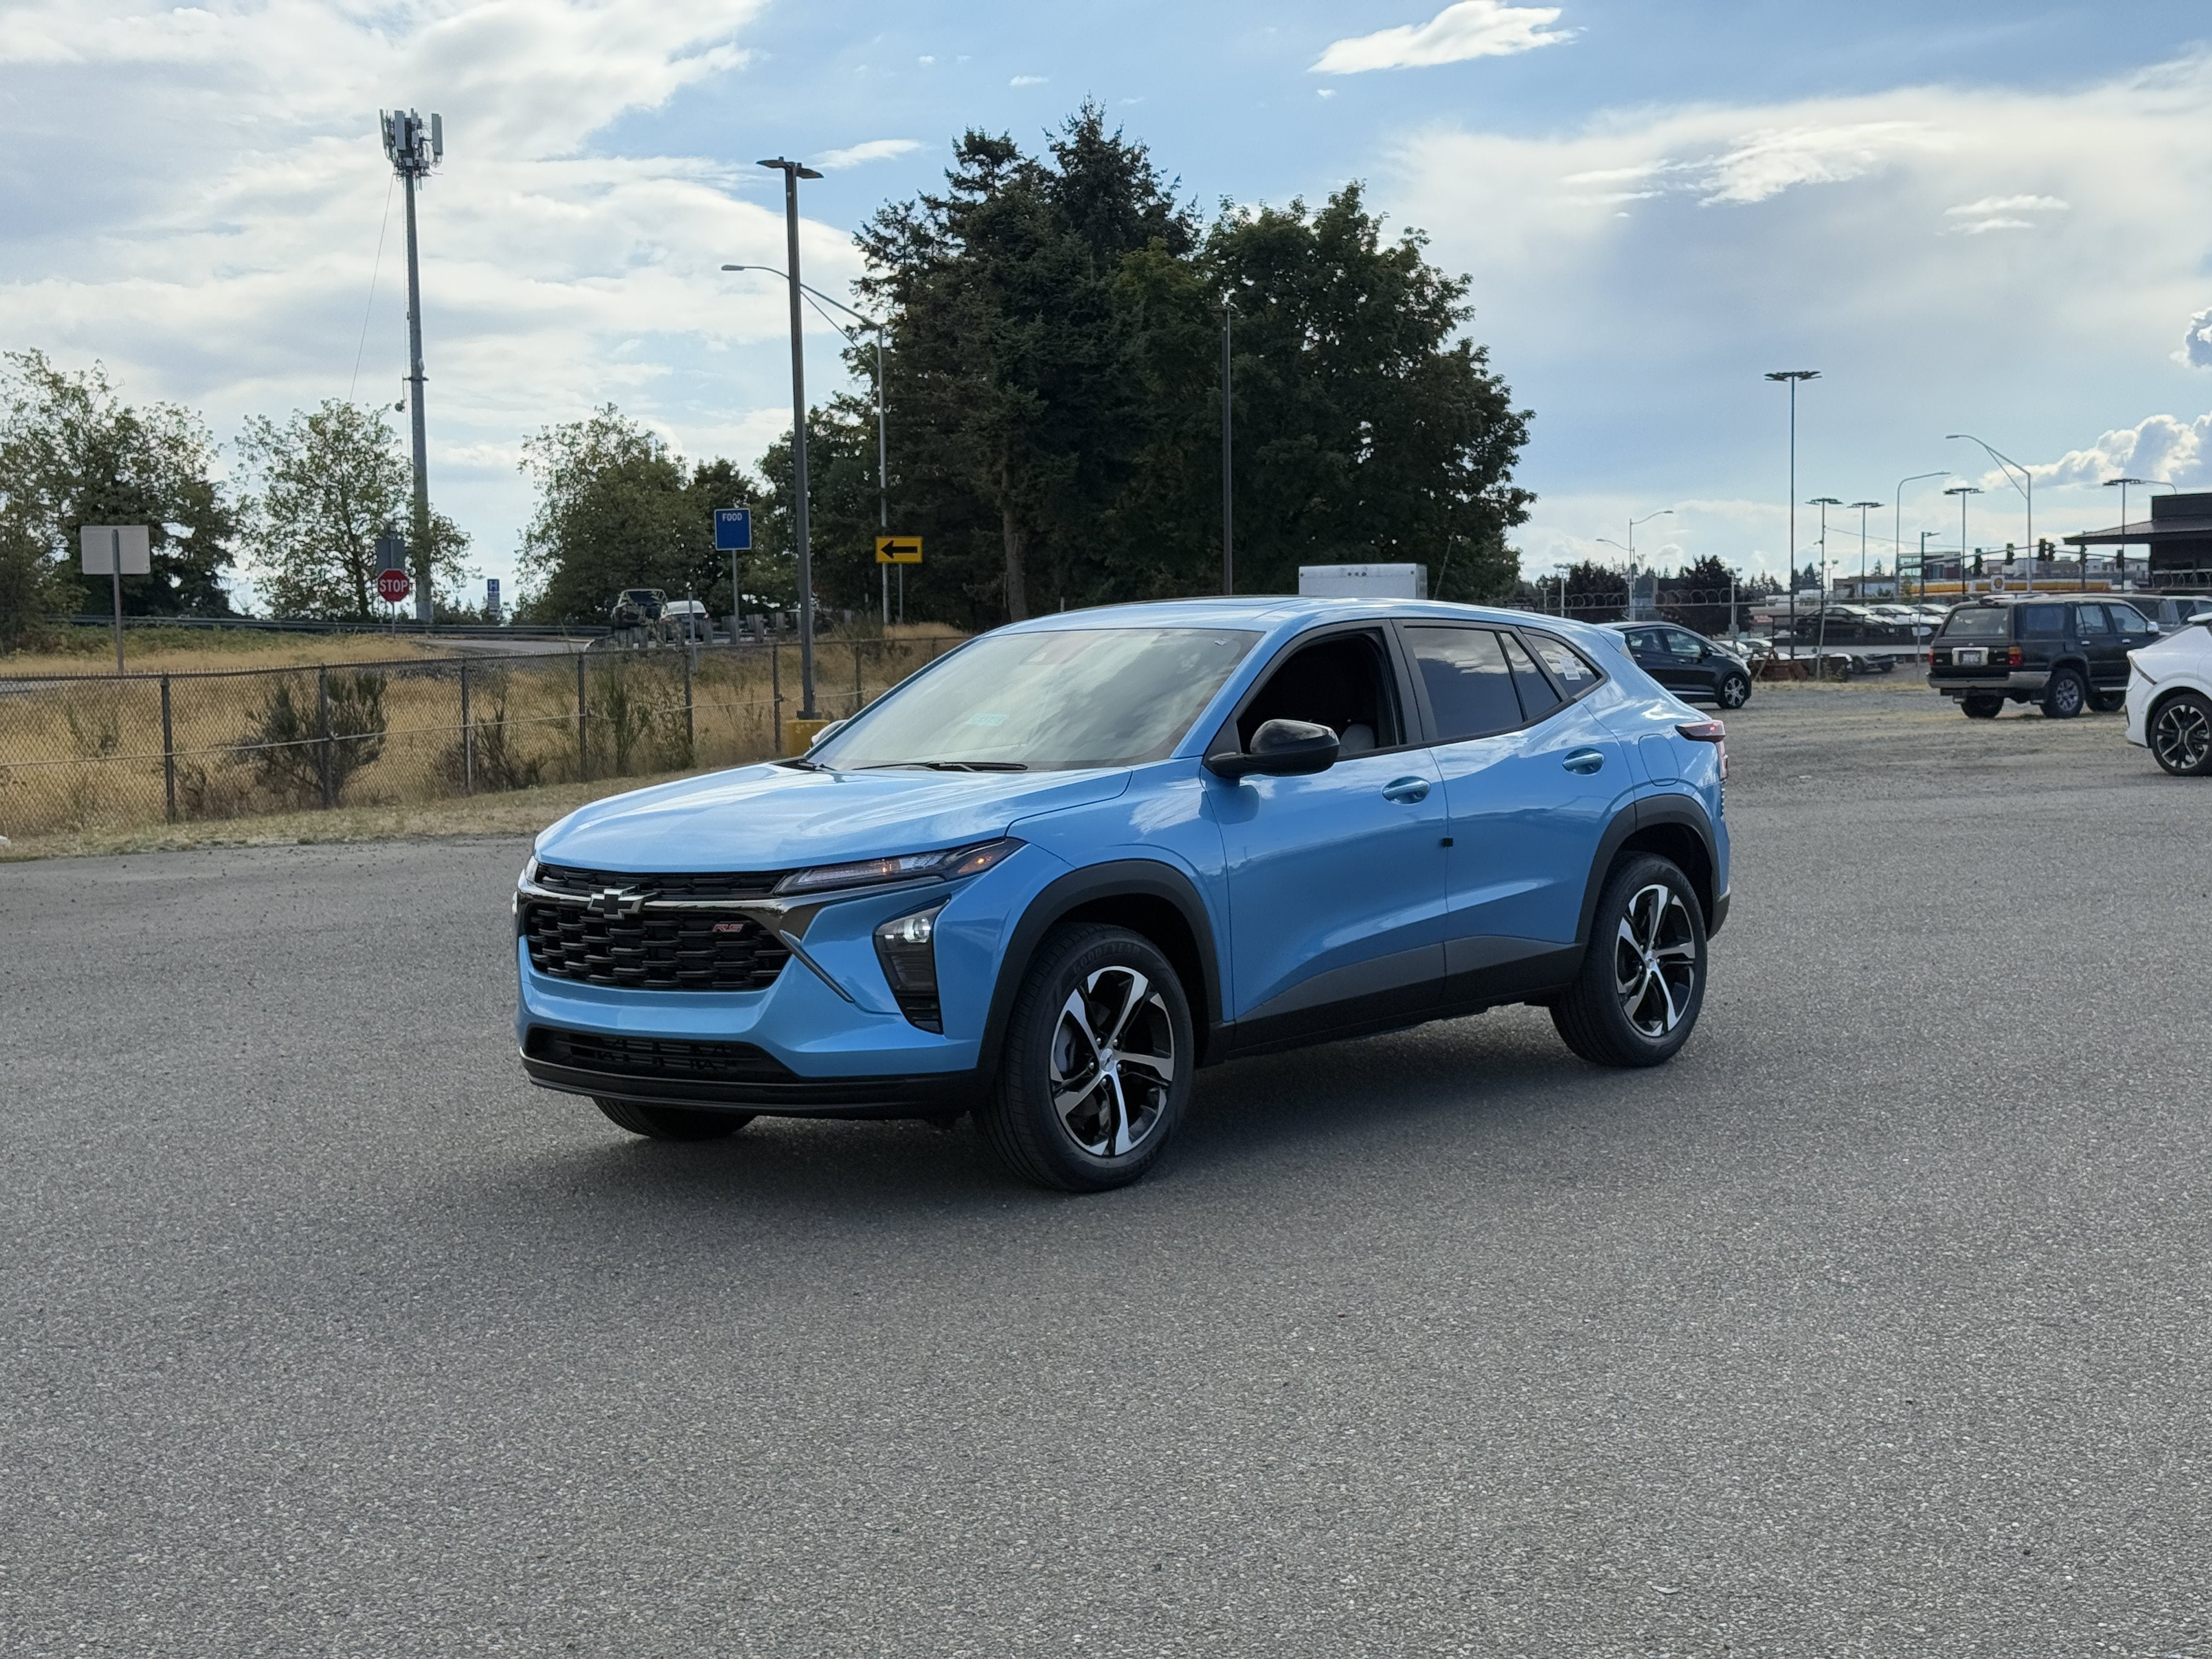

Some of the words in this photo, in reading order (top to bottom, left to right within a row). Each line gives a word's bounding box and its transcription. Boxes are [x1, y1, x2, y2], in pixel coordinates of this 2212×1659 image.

[722, 512, 743, 522] FOOD
[379, 579, 408, 593] STOP
[712, 924, 744, 933] RS
